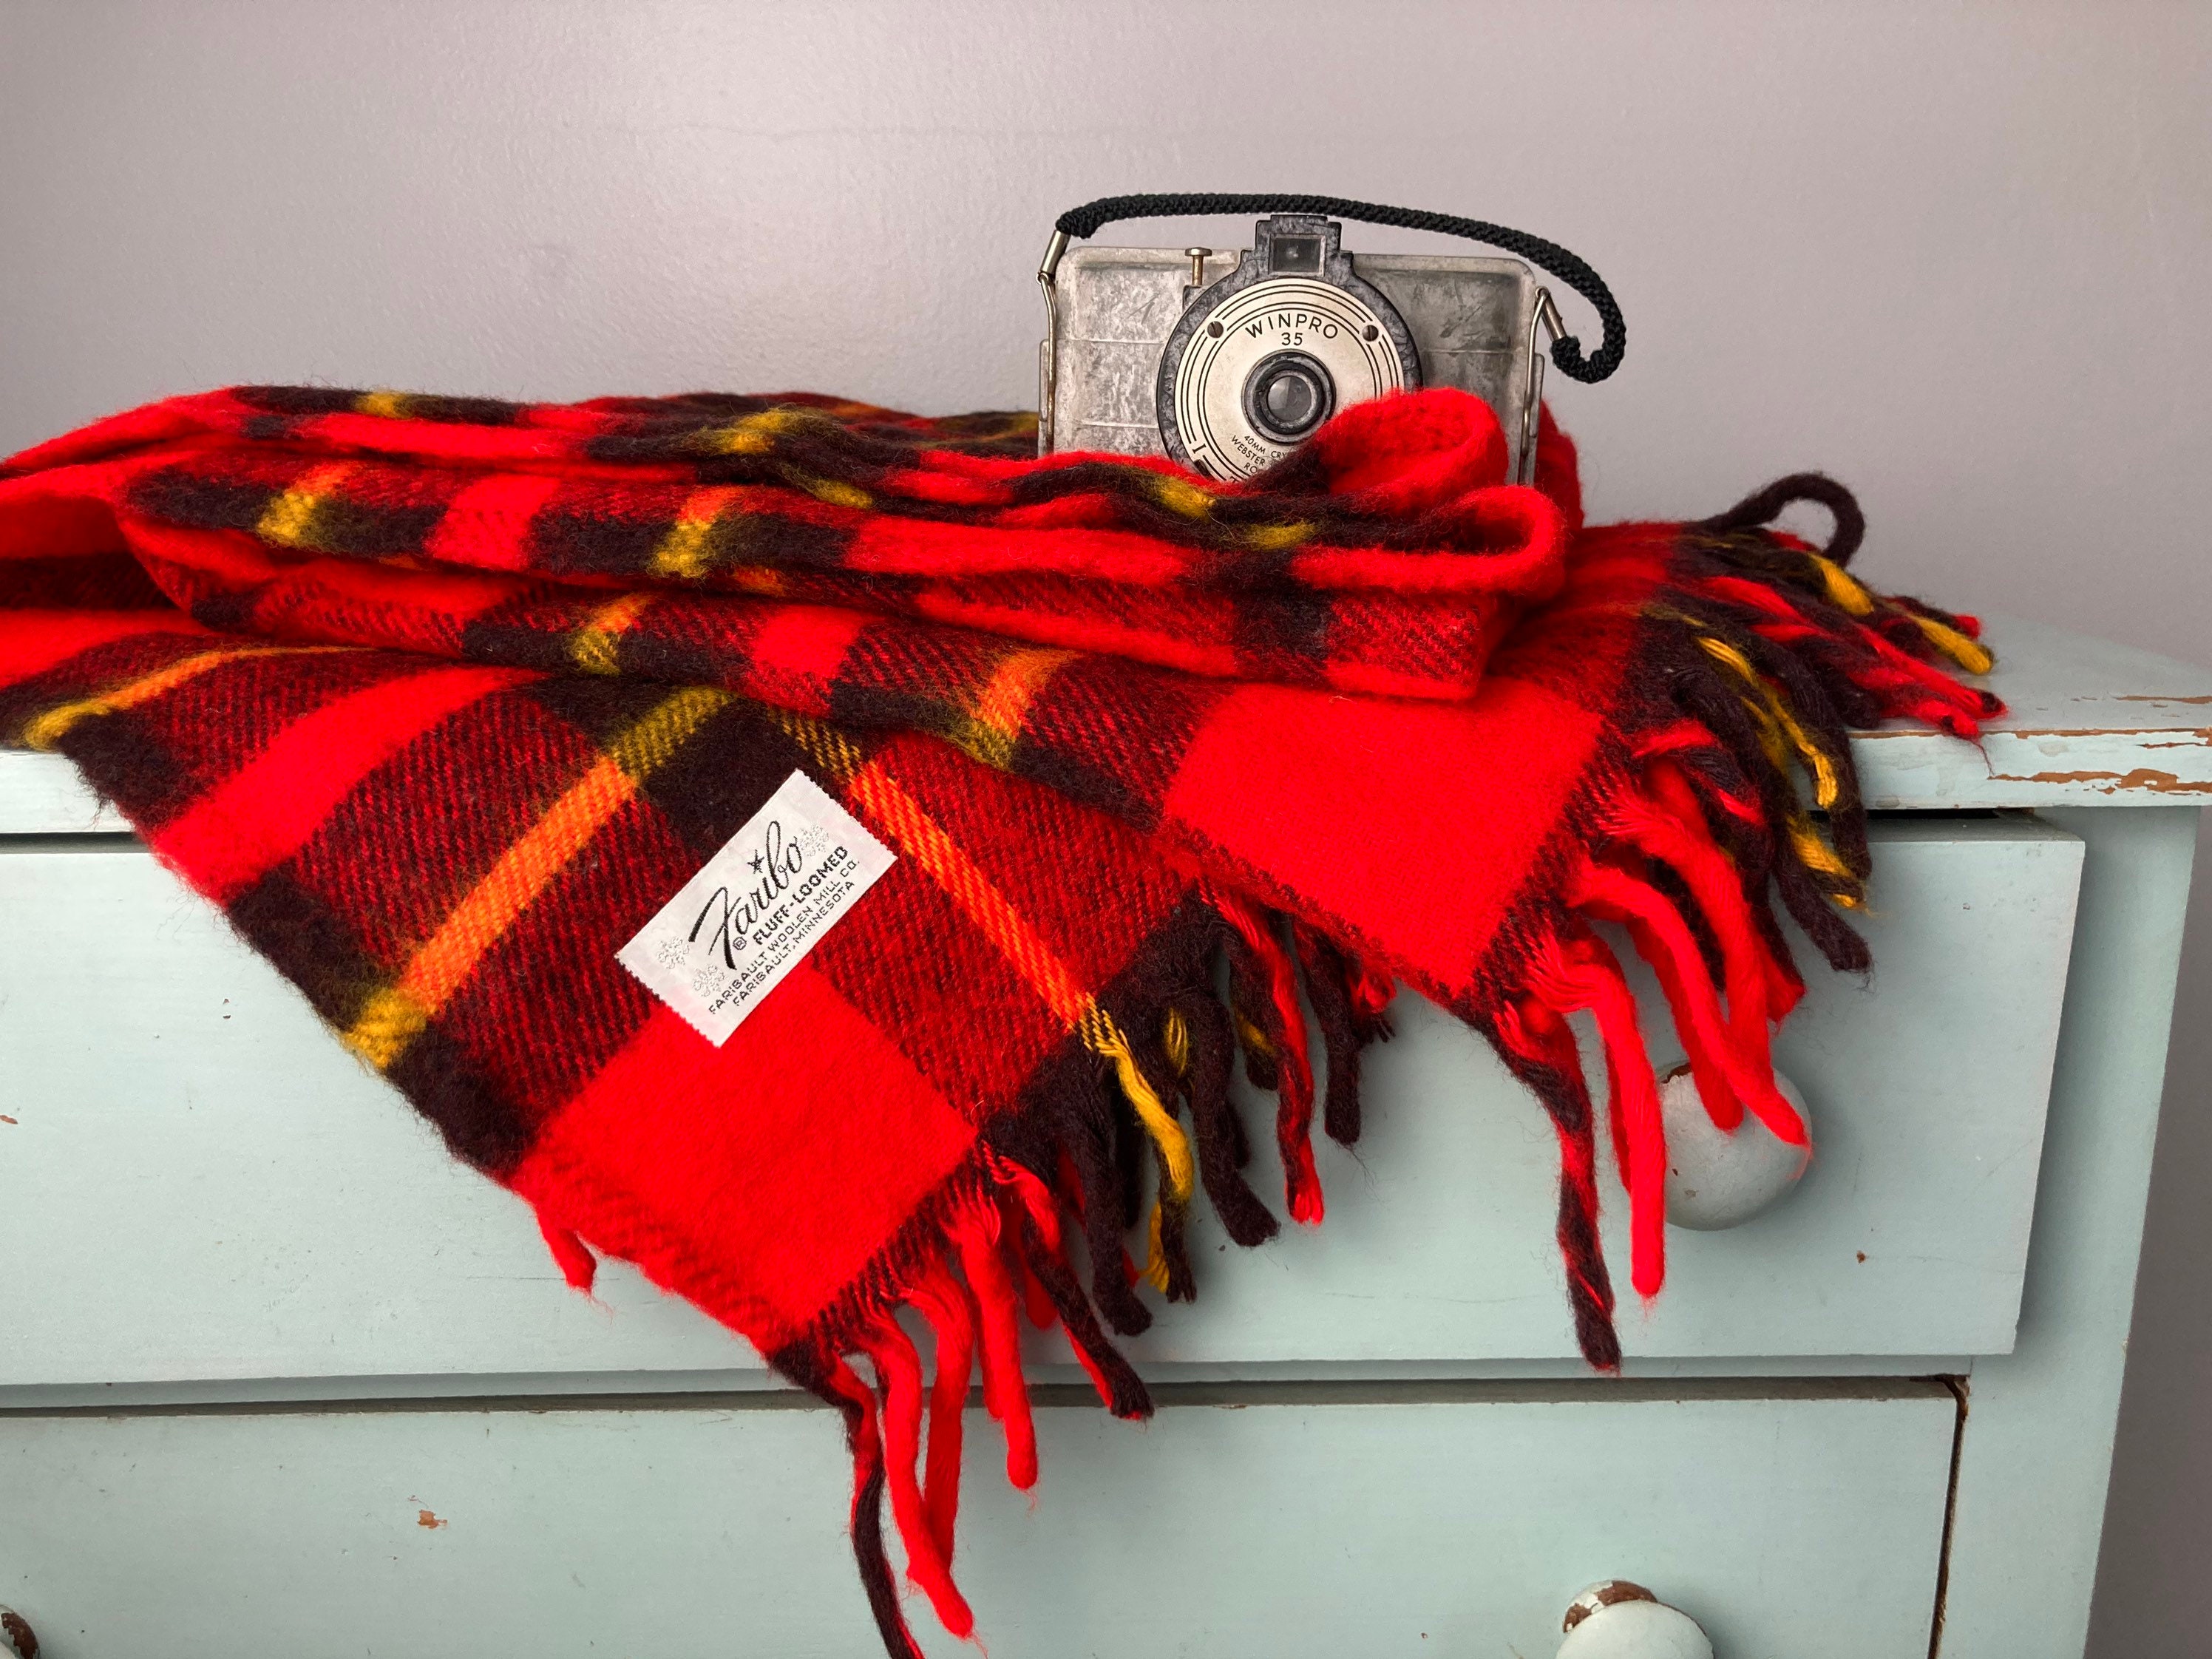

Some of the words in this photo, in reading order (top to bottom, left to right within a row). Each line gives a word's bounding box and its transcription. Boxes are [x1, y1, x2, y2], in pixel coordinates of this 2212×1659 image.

[1244, 313, 1339, 339] WINPRO
[1281, 333, 1303, 346] 35
[1231, 435, 1266, 467] WEBSTER
[1244, 435, 1266, 455] 40MM
[688, 820, 804, 971] Faribo
[752, 845, 849, 946] FLUFF-LOOMED
[793, 881, 855, 944] MINNESOTA
[708, 951, 767, 1014] FARIBAULT
[767, 906, 814, 952] WOOLEN
[813, 881, 841, 906] MILL
[840, 860, 860, 878] CO.
